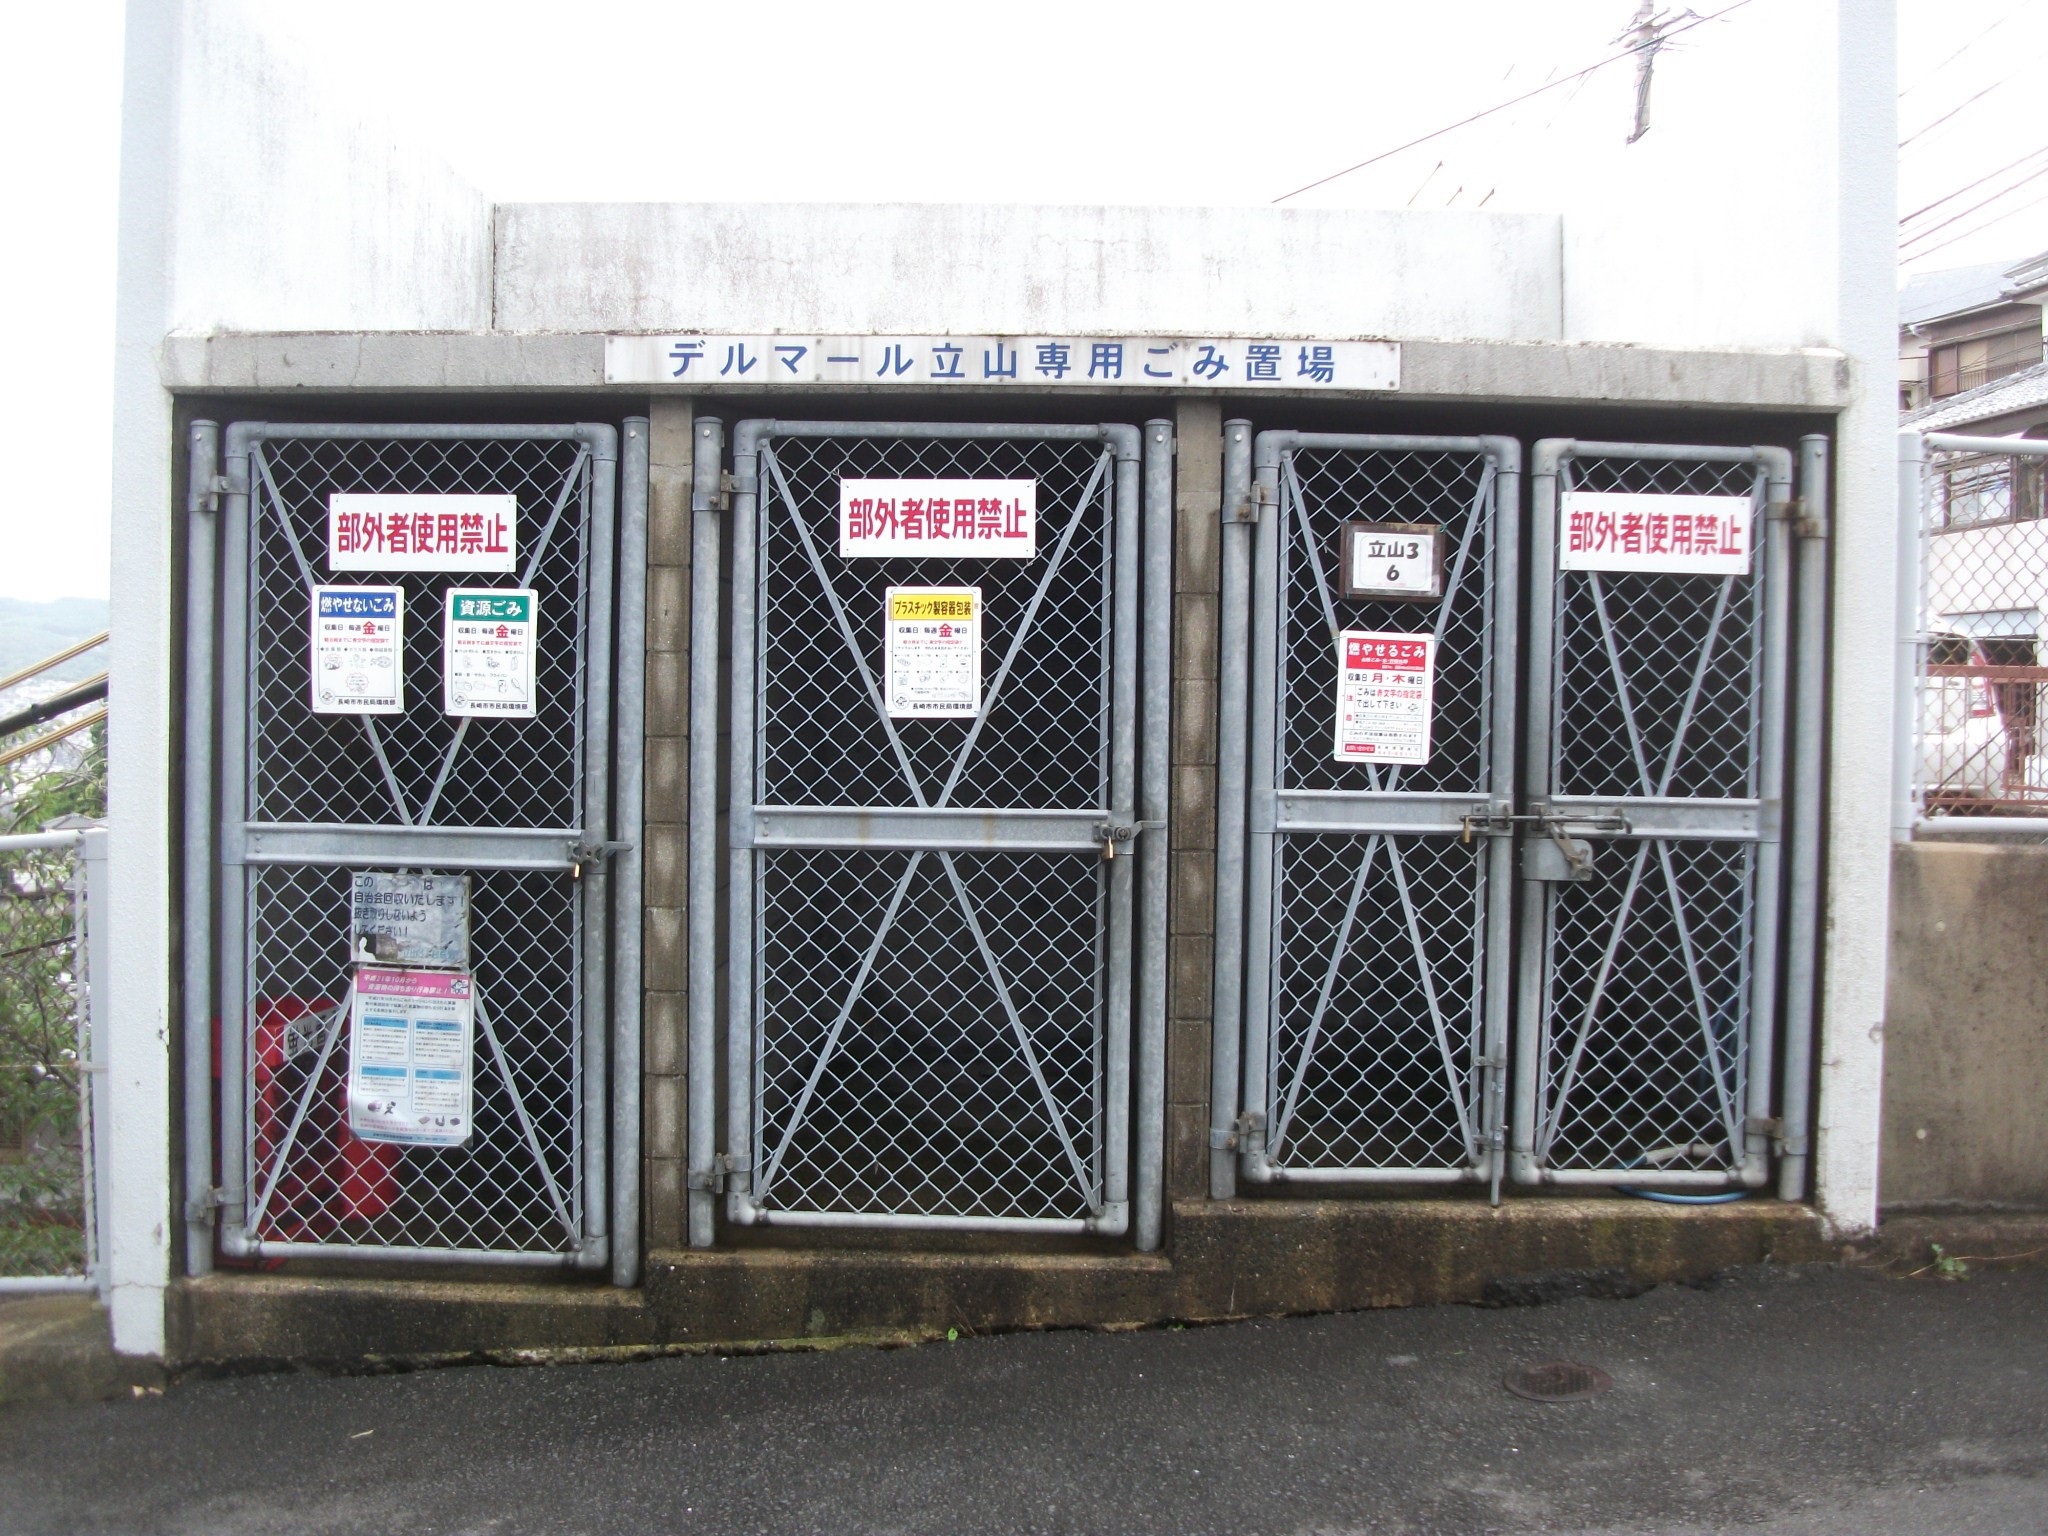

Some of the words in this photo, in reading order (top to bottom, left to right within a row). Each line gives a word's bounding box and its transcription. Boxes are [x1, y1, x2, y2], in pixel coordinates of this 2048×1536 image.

[668, 340, 1335, 384] デルマール立山専用ごみ置場
[849, 498, 1028, 540] 部外者使用禁止
[338, 512, 509, 555] 部外者使用禁止
[1569, 511, 1742, 555] 部外者使用禁止
[1368, 540, 1419, 560] 立山3
[1386, 564, 1400, 581] 6
[320, 596, 395, 613] 燃やせないごみ
[460, 599, 522, 616] 資源ごみ
[895, 600, 971, 615] プラスチック製容器包装
[1348, 642, 1425, 658] 燃やせるごみ
[355, 876, 373, 888] この
